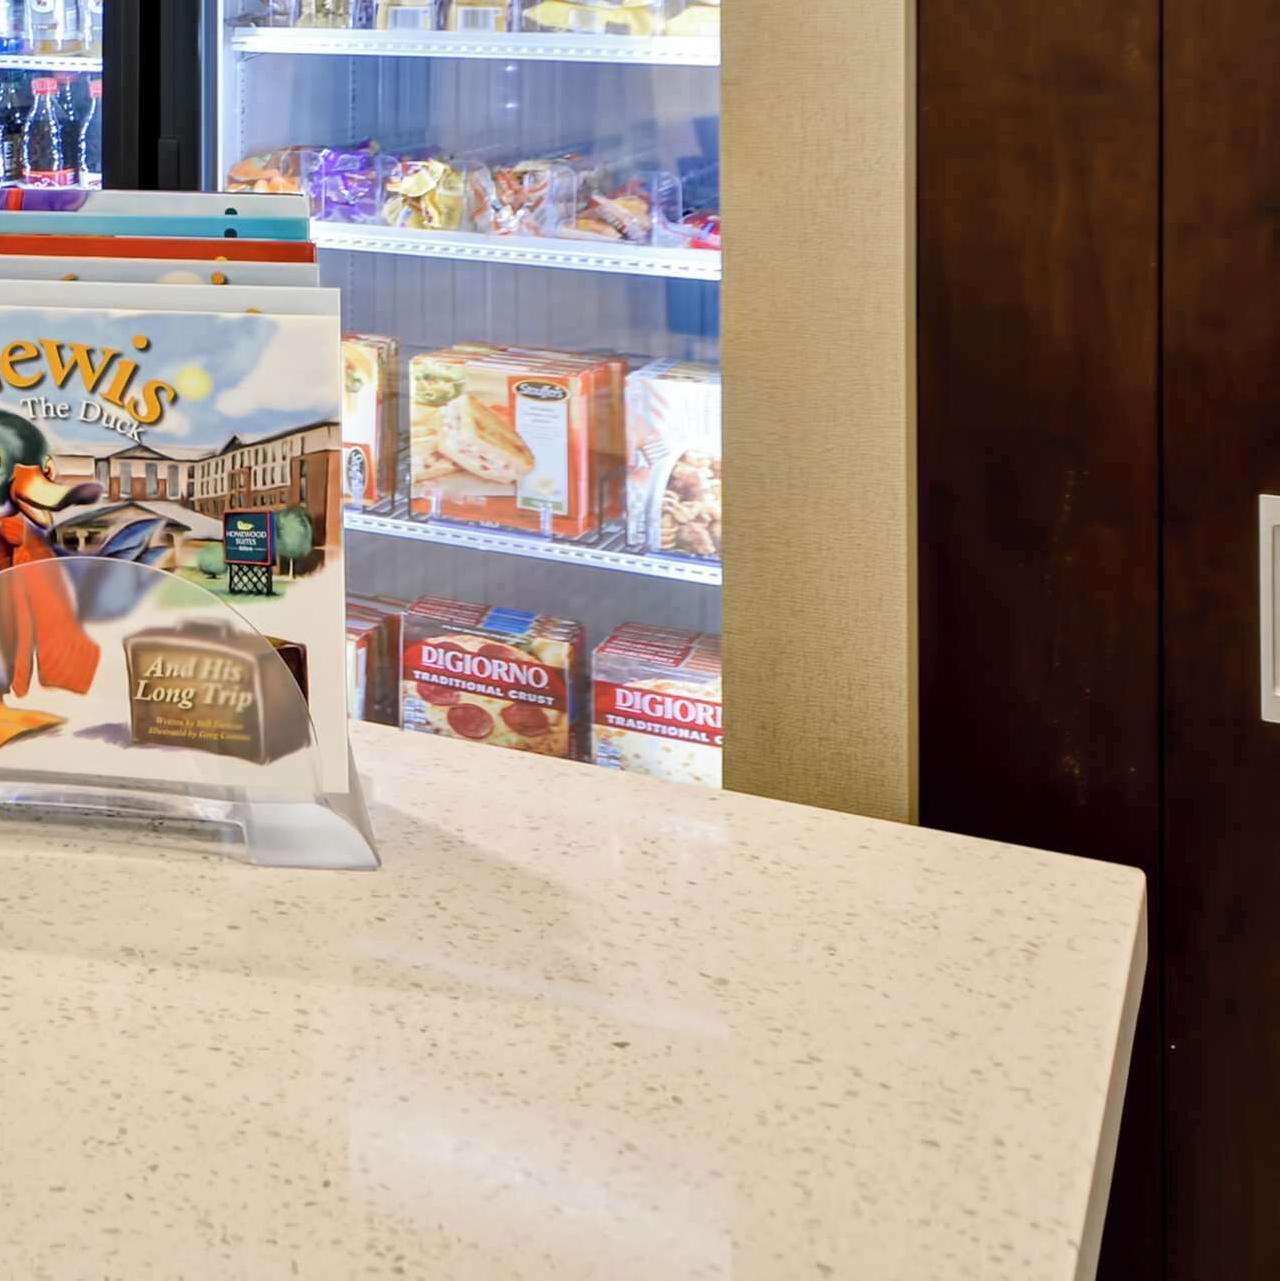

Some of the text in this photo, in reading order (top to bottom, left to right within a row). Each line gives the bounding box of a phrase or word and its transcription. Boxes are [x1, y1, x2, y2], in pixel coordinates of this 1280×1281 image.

[20, 397, 146, 441] The Duck
[143, 655, 243, 682] And His
[422, 645, 549, 688] DIGIORNO
[133, 679, 253, 713] Long Trip
[413, 670, 556, 706] TRADITIONAL CRUST
[606, 714, 710, 744] TRADITIONAL
